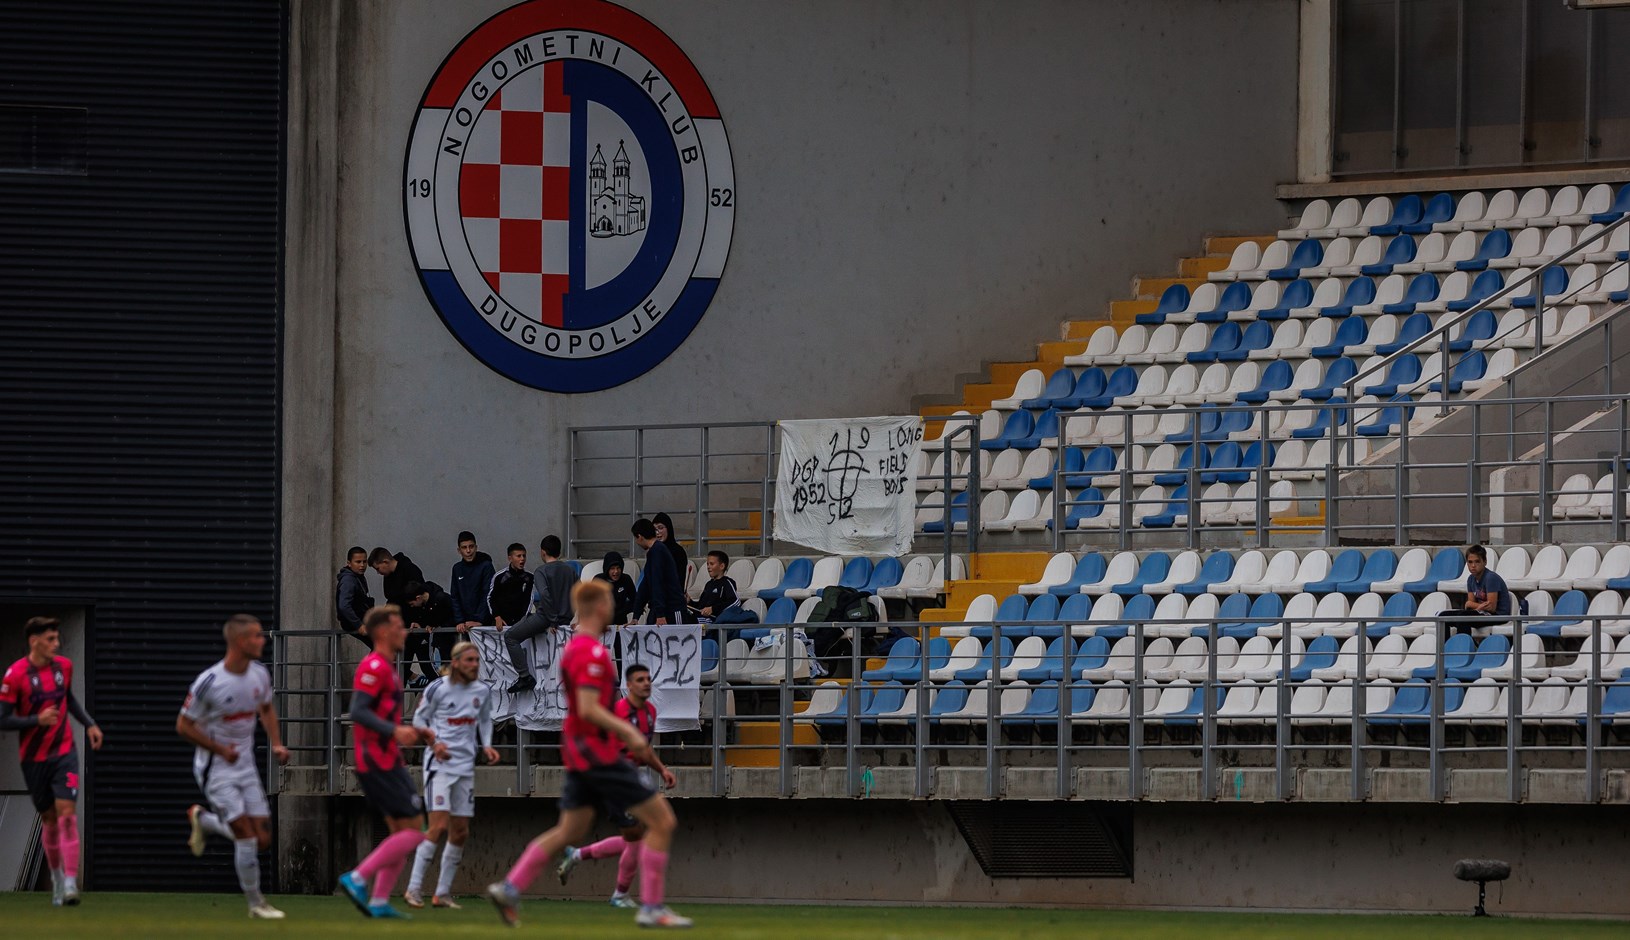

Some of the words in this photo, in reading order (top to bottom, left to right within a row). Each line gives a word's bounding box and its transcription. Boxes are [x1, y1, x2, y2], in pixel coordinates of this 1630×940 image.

[443, 35, 621, 157] NOGOMETNI
[640, 70, 699, 165] KLUB
[409, 179, 431, 199] 19
[710, 188, 733, 208] 52
[480, 294, 662, 355] DUGOPOLJE
[888, 426, 923, 451] LONG
[791, 456, 819, 485] DGP
[792, 482, 826, 515] 1952
[626, 629, 698, 687] 1952
